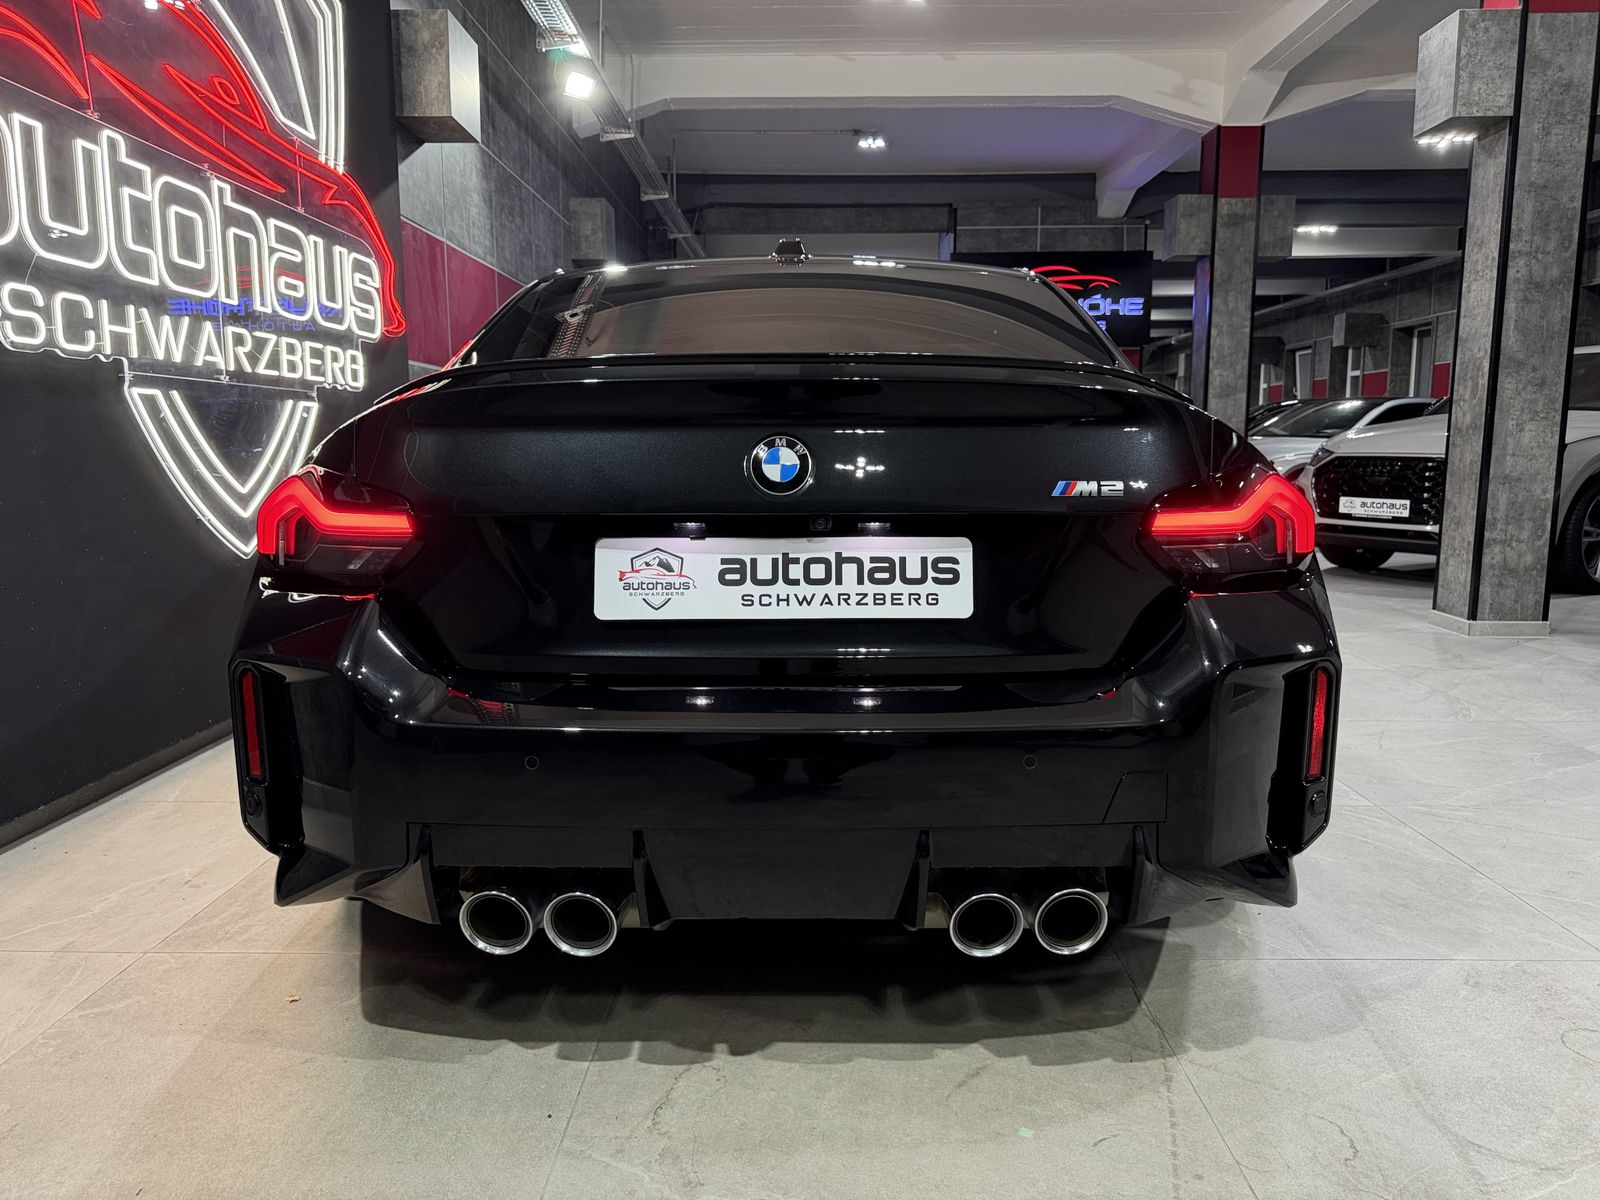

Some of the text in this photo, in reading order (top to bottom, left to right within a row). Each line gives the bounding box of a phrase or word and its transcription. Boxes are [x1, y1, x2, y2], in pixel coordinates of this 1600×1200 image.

[0, 112, 383, 343] utohaus
[0, 282, 364, 388] SCHWARZBERG
[757, 437, 807, 457] BMW
[1071, 480, 1124, 497] M2
[1360, 501, 1408, 511] autohaus
[717, 551, 961, 587] autohaus
[622, 580, 691, 591] autohaus
[740, 592, 940, 607] SCHWARZBERG
